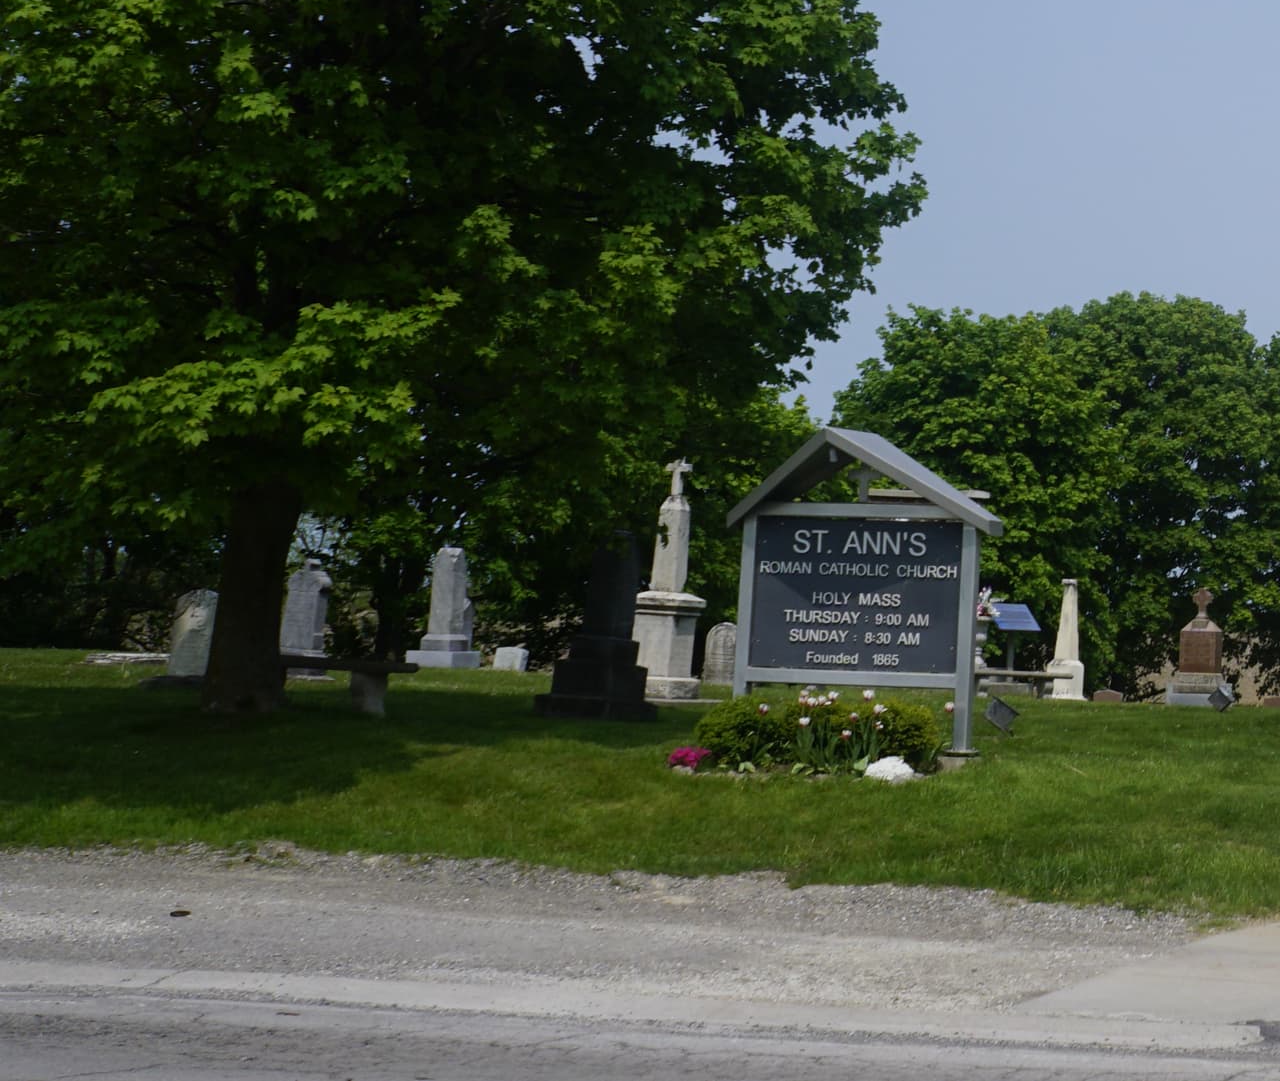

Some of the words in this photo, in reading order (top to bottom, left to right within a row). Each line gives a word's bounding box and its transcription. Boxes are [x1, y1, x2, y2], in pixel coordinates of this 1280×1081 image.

[792, 529, 832, 554] ST.
[842, 530, 927, 557] ANN'S
[759, 560, 812, 575] ROMAN
[819, 562, 889, 577] CATHOLIC
[896, 564, 958, 579] CHURCH
[812, 591, 851, 605] HOLY
[858, 592, 901, 607] MASS
[784, 609, 860, 625] THURSDAY
[874, 613, 901, 626] 9:00
[906, 614, 929, 627] AM
[789, 628, 848, 643] SUNDAY
[864, 631, 891, 645] 8:30
[896, 632, 920, 646] AM
[805, 651, 859, 665] Founded
[871, 653, 899, 666] 1865
